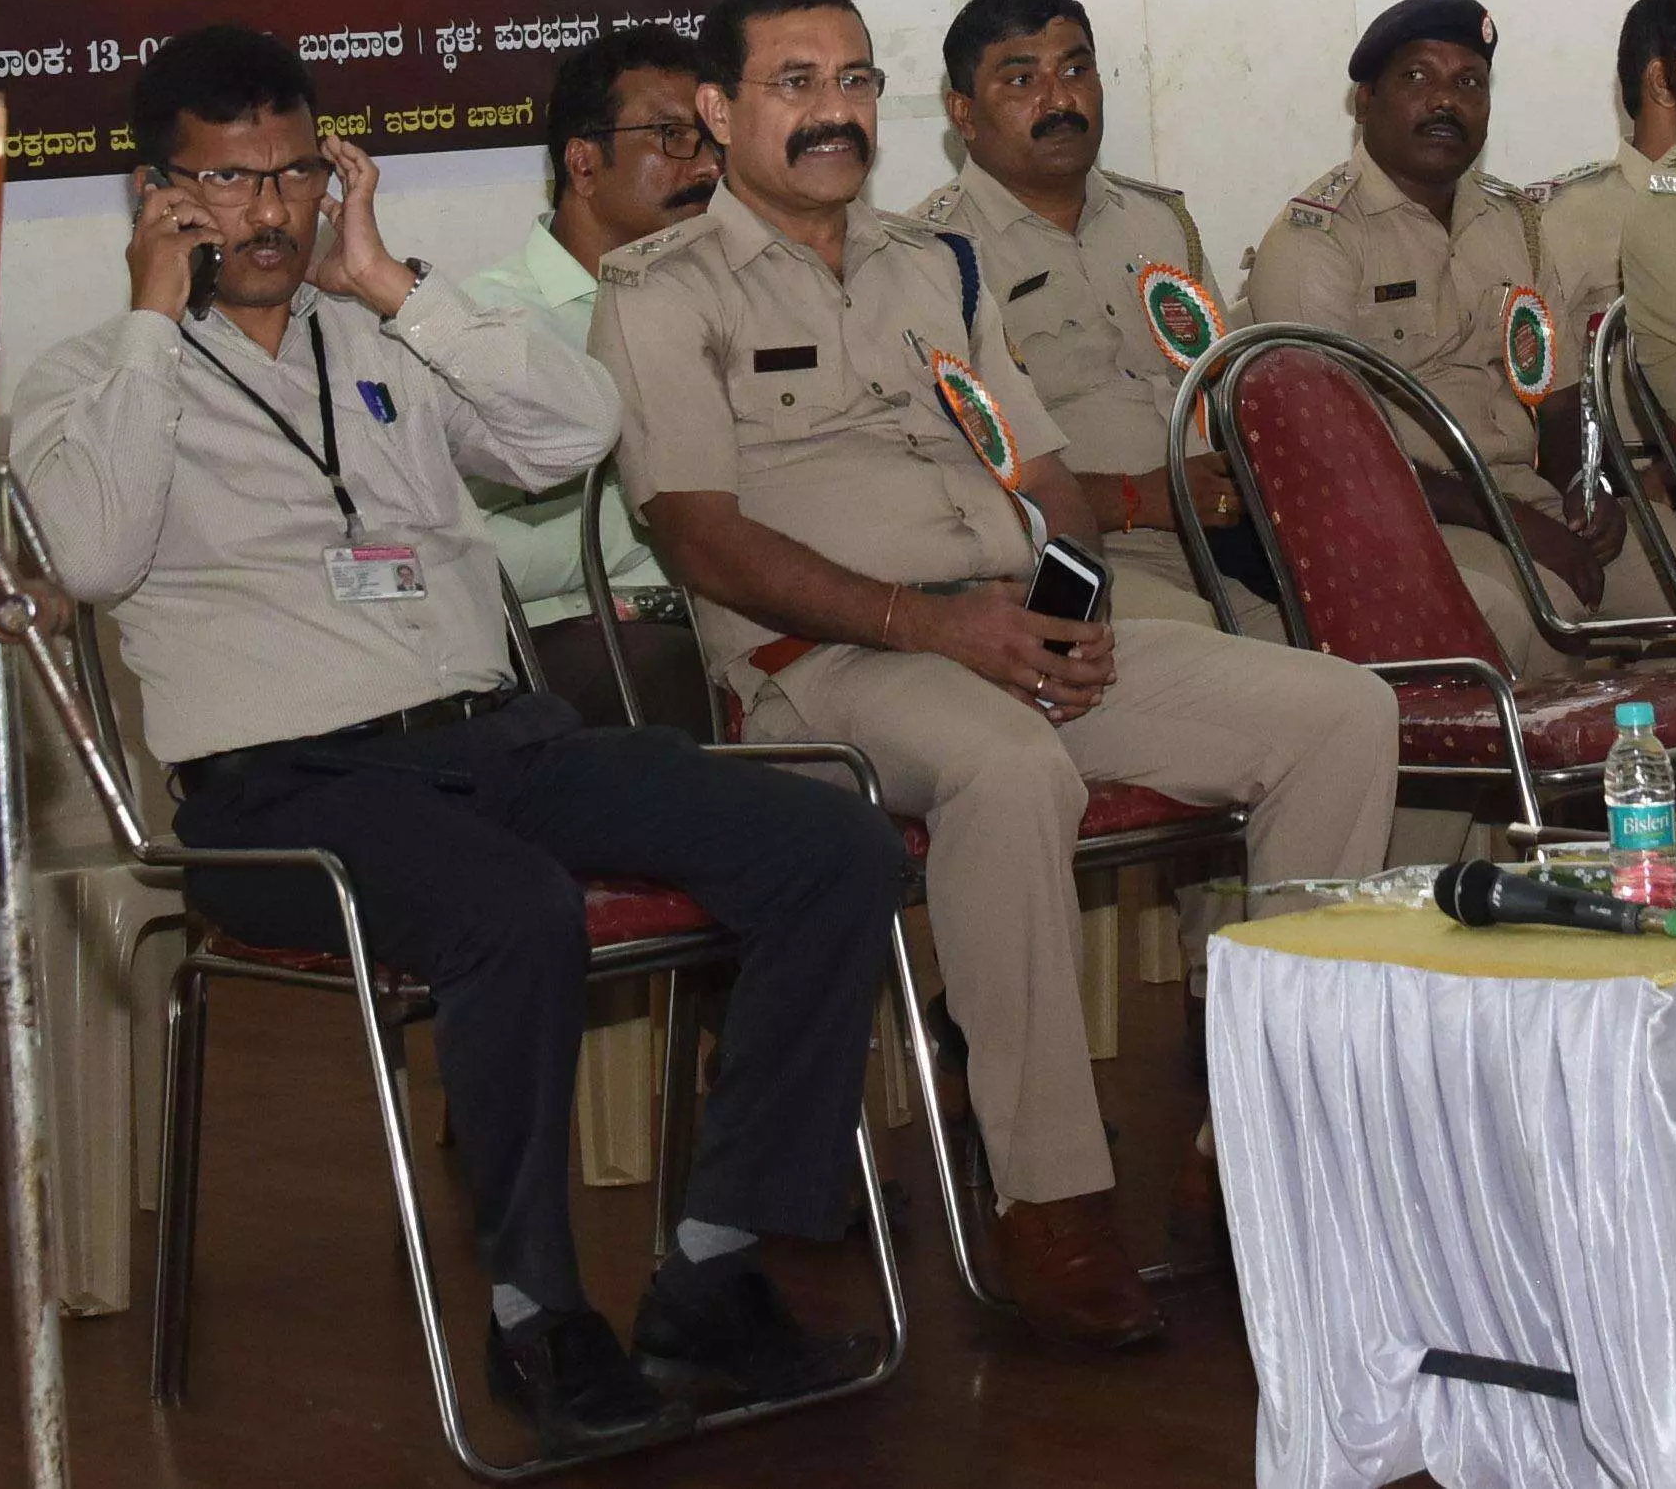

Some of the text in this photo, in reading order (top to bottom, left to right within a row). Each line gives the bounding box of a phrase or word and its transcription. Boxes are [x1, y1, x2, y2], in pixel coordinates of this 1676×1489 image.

[299, 23, 403, 66] ಬುಧವಾರ
[436, 19, 482, 73] ಸ್ಥಳ:
[494, 13, 601, 54] ಪುರಭವನ
[3, 126, 97, 167] ರಕ್ತದಾನ
[384, 106, 455, 135] ಇತರರ
[467, 96, 534, 129] ಬಾಳಿಗೆ
[1623, 812, 1669, 835] Bisleri
